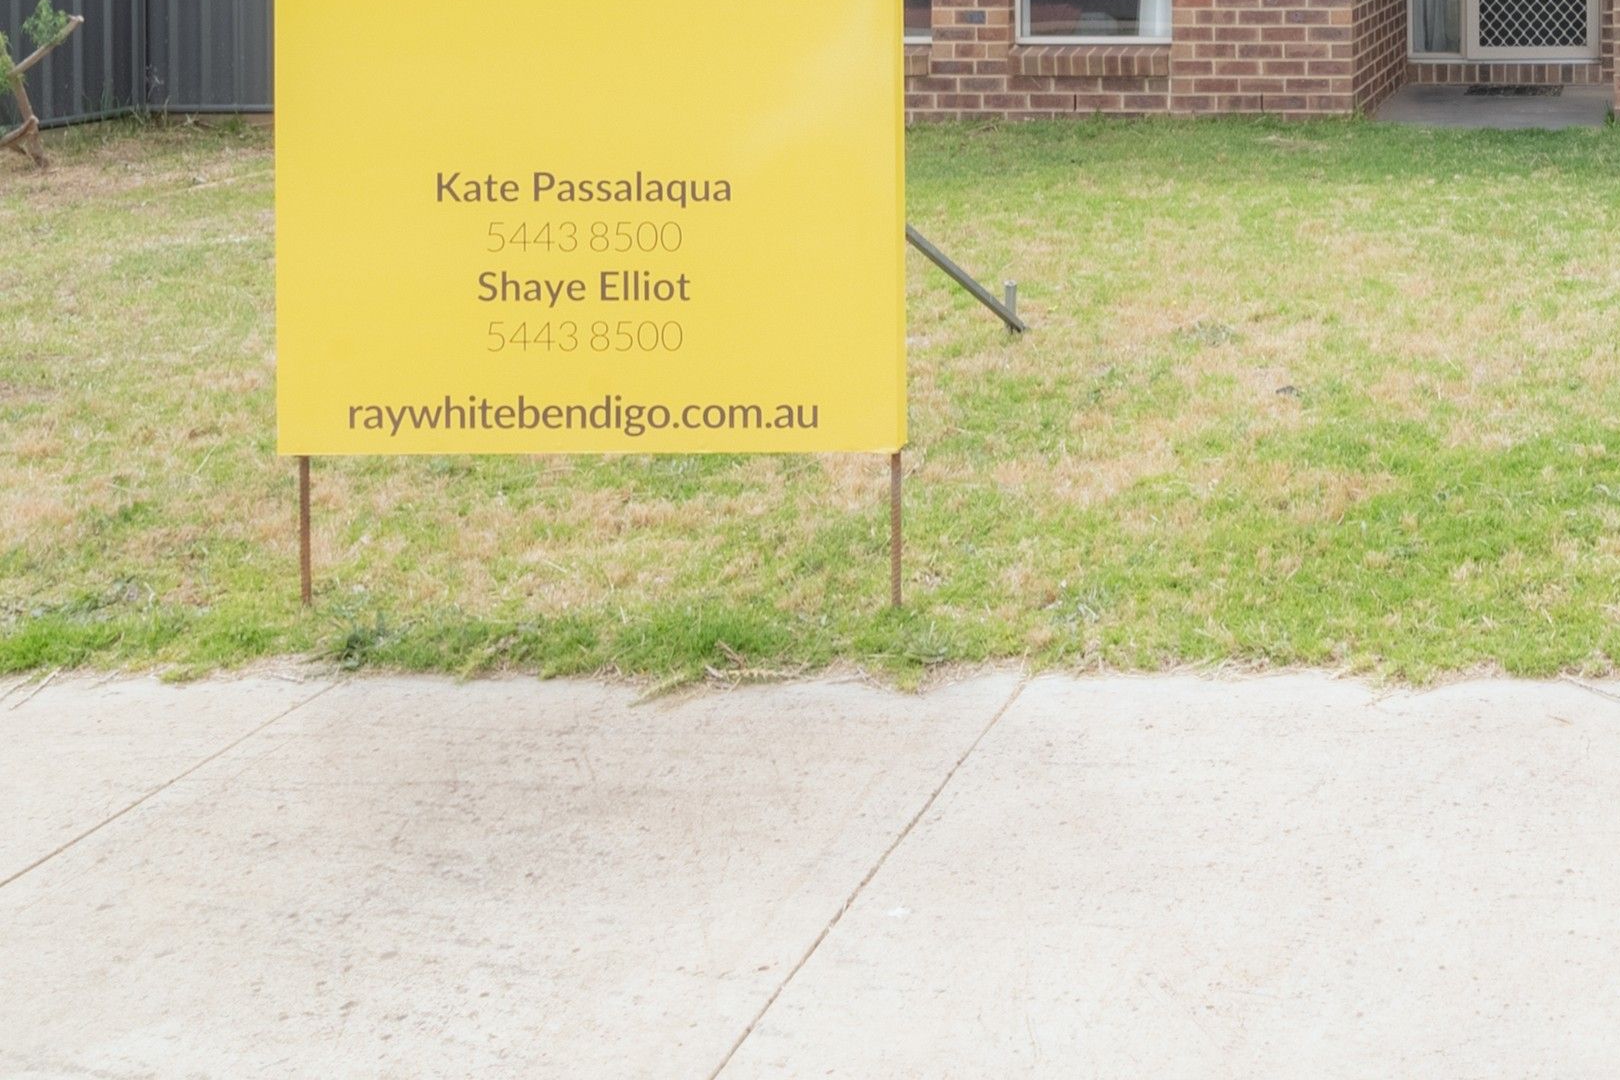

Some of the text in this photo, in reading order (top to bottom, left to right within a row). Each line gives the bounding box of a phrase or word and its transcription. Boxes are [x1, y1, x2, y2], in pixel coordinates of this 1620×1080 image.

[436, 170, 732, 209] Kate Passalaqua
[487, 221, 683, 253] 5443 8500
[478, 270, 691, 309] Shaye Elliot
[487, 320, 683, 352] 5443 8500
[348, 394, 819, 437] raywhitebendigo.com.au
